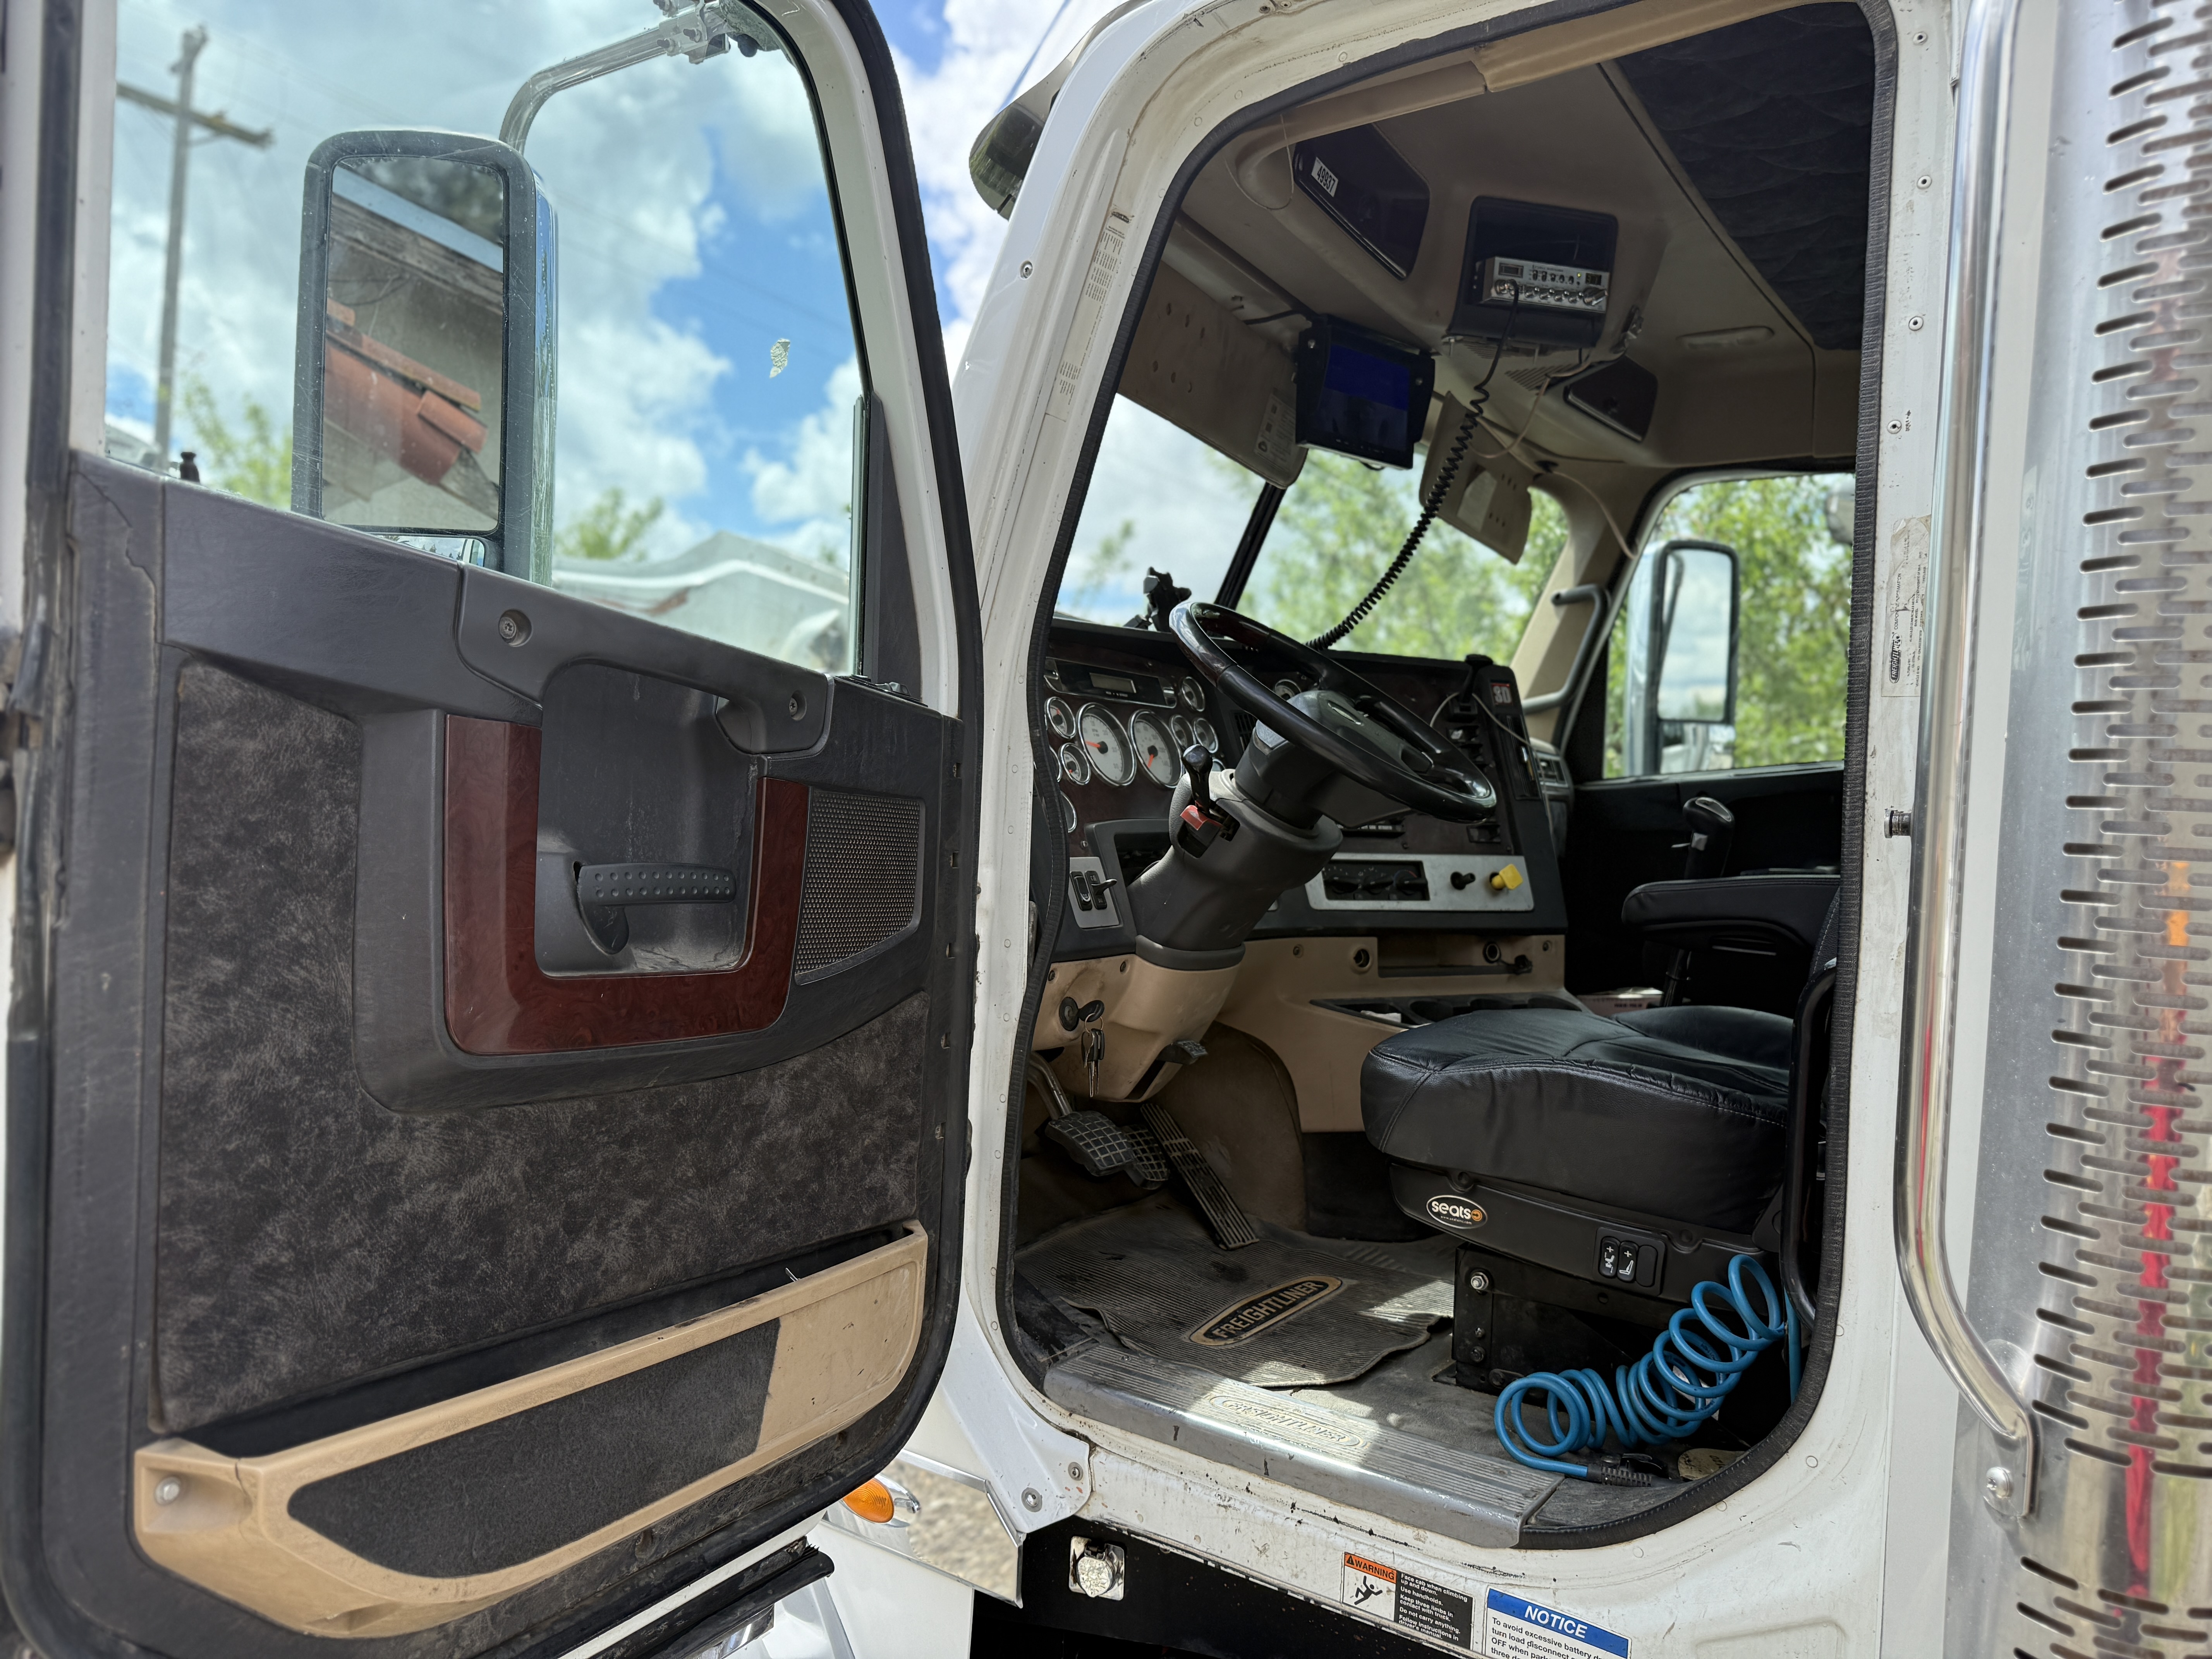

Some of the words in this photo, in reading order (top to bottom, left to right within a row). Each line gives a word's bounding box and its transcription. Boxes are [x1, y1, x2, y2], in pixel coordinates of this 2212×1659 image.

[1317, 166, 1336, 193] 49937
[1432, 1201, 1471, 1219] seats
[1212, 1282, 1324, 1338] FREIGHTLINER
[1228, 1403, 1346, 1441] FREIGHTLINER
[1355, 1559, 1395, 1580] WARNING
[1401, 1573, 1414, 1582] Face
[1427, 1583, 1442, 1592] when
[1443, 1589, 1468, 1602] climbing
[1412, 1589, 1443, 1606] handholds.
[1421, 1586, 1438, 1595] down.
[1400, 1594, 1414, 1604] Keep
[1415, 1600, 1430, 1608] three
[1431, 1605, 1446, 1615] limbs
[1400, 1600, 1420, 1610] contact
[1435, 1612, 1451, 1621] truck.
[1399, 1614, 1417, 1625] Follow
[1419, 1622, 1452, 1638] instructions
[1399, 1620, 1419, 1631] driver's
[1420, 1628, 1443, 1640] manual.
[1419, 1614, 1433, 1624] carry
[1435, 1620, 1460, 1634] anything.
[1524, 1605, 1587, 1638] NOTICE
[1491, 1637, 1507, 1647] OFF
[1508, 1644, 1529, 1656] when
[1492, 1617, 1501, 1626] To
[1503, 1623, 1523, 1634] avoid
[1525, 1630, 1562, 1648] excessive
[1565, 1643, 1592, 1659] battery
[1492, 1627, 1507, 1638] turn
[1509, 1633, 1525, 1645] load
[1527, 1641, 1569, 1659] disconnect
[1491, 1647, 1510, 1659] three
